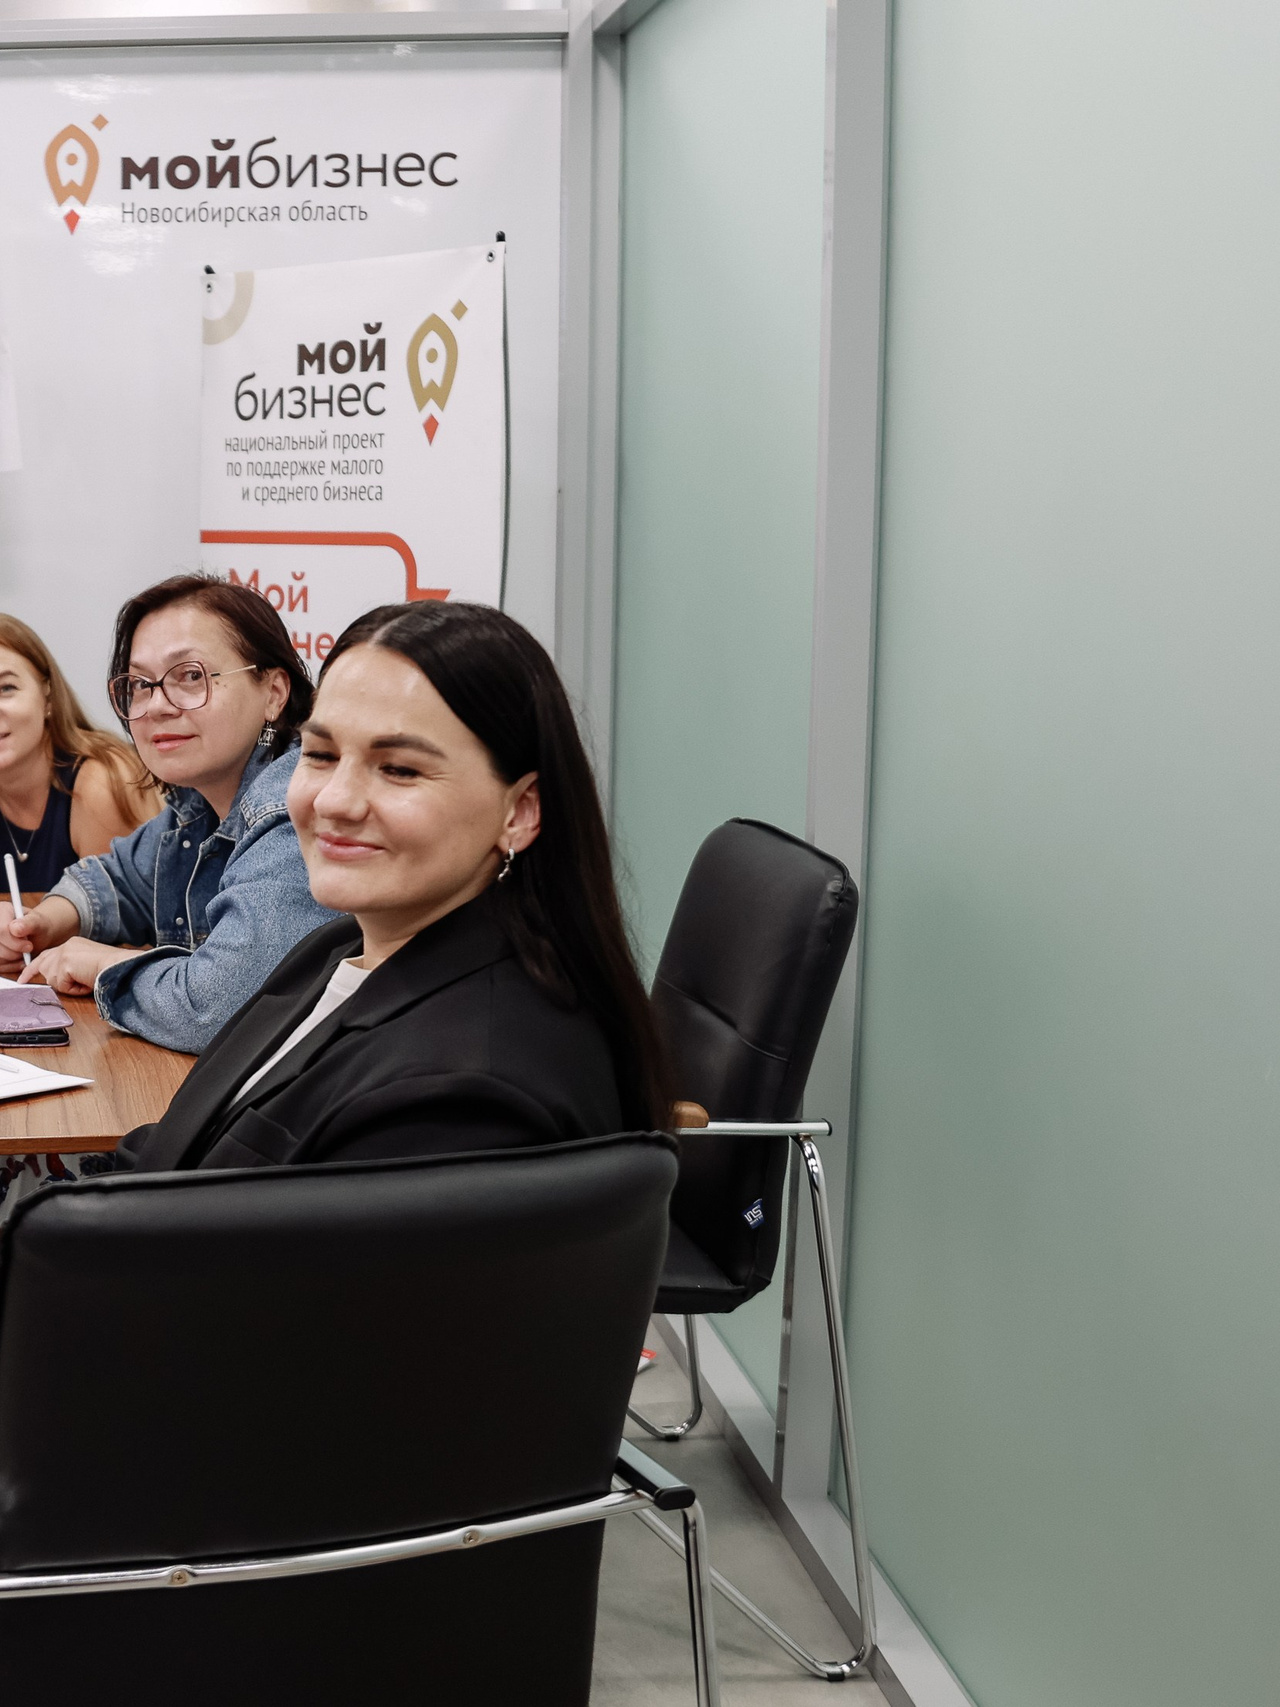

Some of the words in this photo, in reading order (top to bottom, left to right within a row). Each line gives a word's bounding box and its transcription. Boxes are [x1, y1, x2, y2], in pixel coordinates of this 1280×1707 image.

[120, 201, 282, 228] Новосибирская
[287, 200, 369, 224] область
[296, 321, 388, 376] мой
[233, 371, 388, 422] бизнес
[223, 429, 329, 455] национальный
[331, 430, 386, 455] проект
[225, 459, 243, 478] по
[245, 458, 327, 482] поддержке
[329, 457, 385, 476] малого
[240, 486, 251, 503] и
[253, 483, 319, 507] среднего
[322, 480, 384, 503] бизнеса
